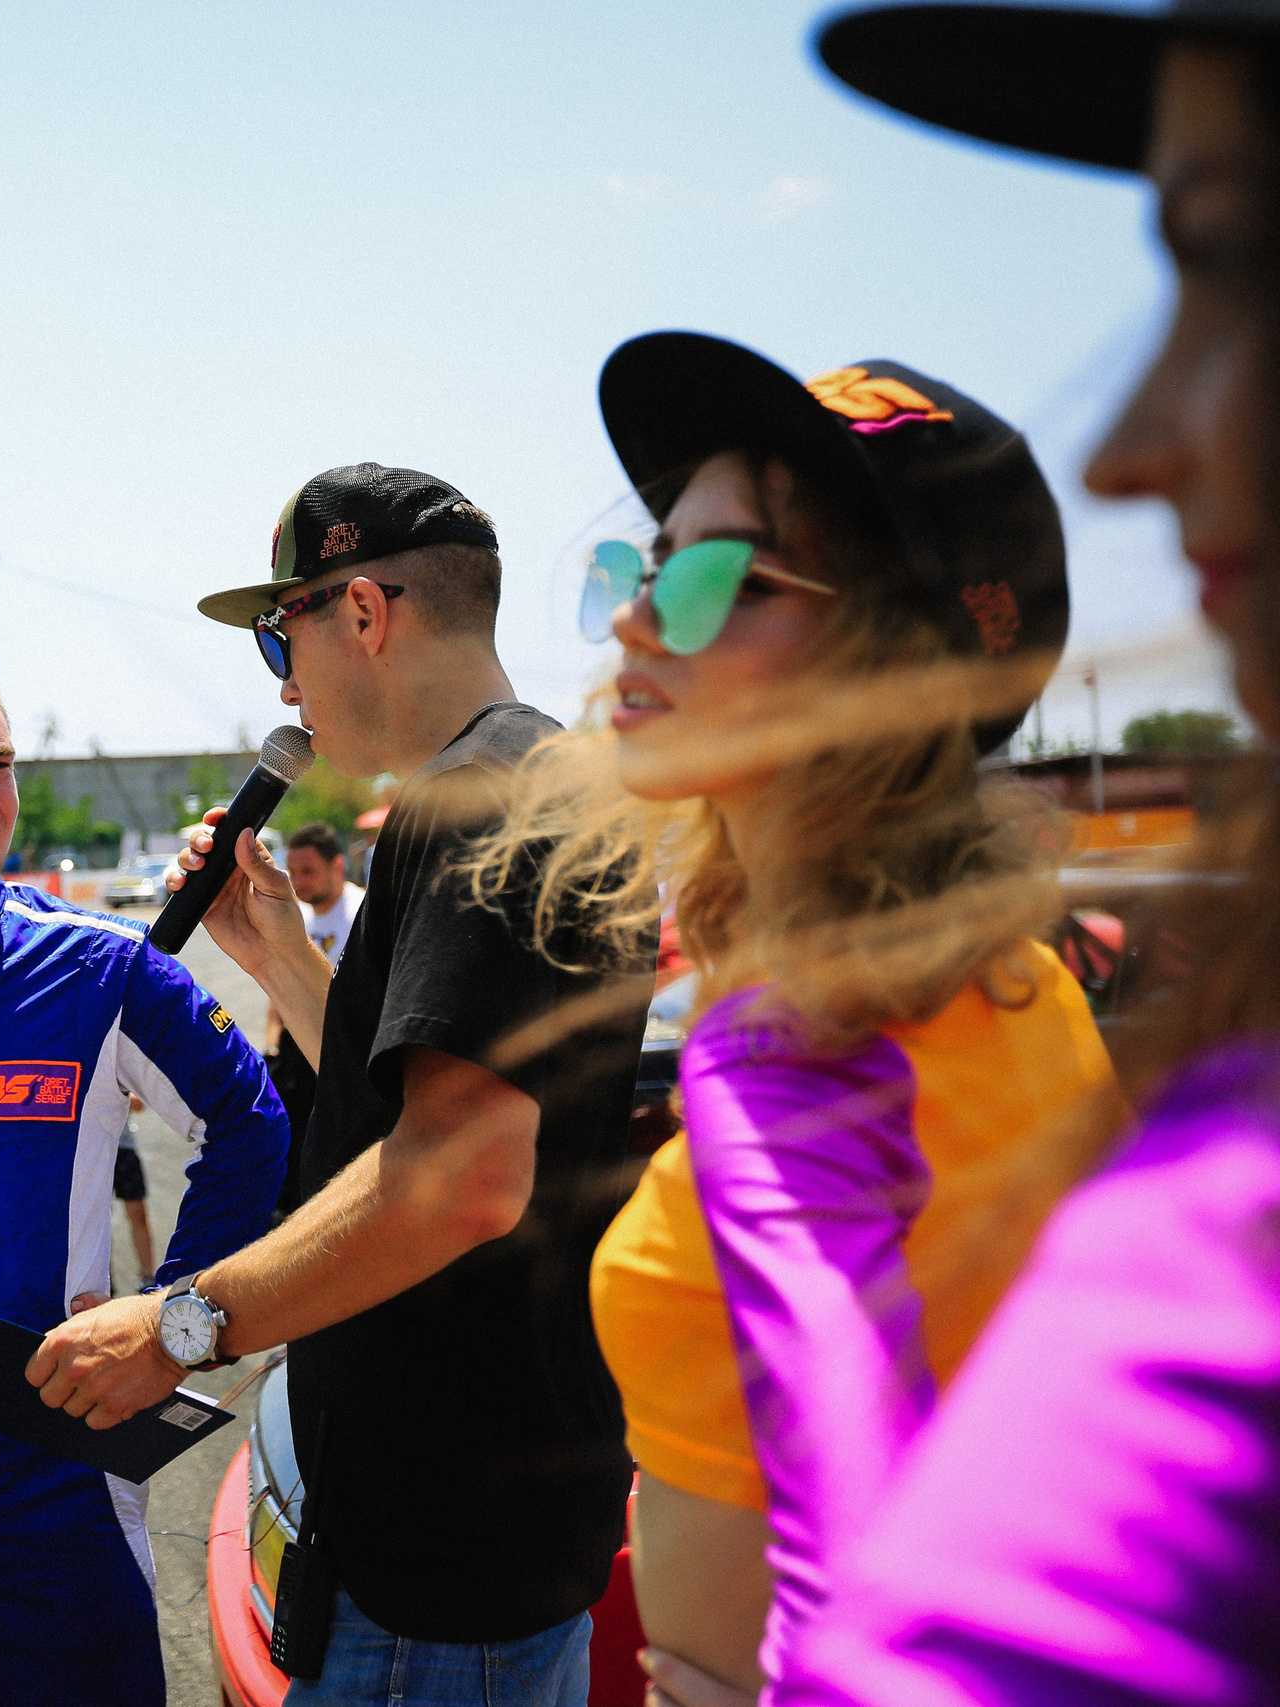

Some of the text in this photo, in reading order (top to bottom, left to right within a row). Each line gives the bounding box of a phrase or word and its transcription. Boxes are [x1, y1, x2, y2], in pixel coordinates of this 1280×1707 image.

[327, 522, 356, 538] DRIFT
[323, 529, 361, 548] BATTLE
[320, 540, 357, 559] SERIES
[213, 1006, 232, 1029] OM
[44, 1077, 70, 1087] DRIFT
[40, 1085, 72, 1096] BATTLE
[34, 1094, 67, 1105] SERIES
